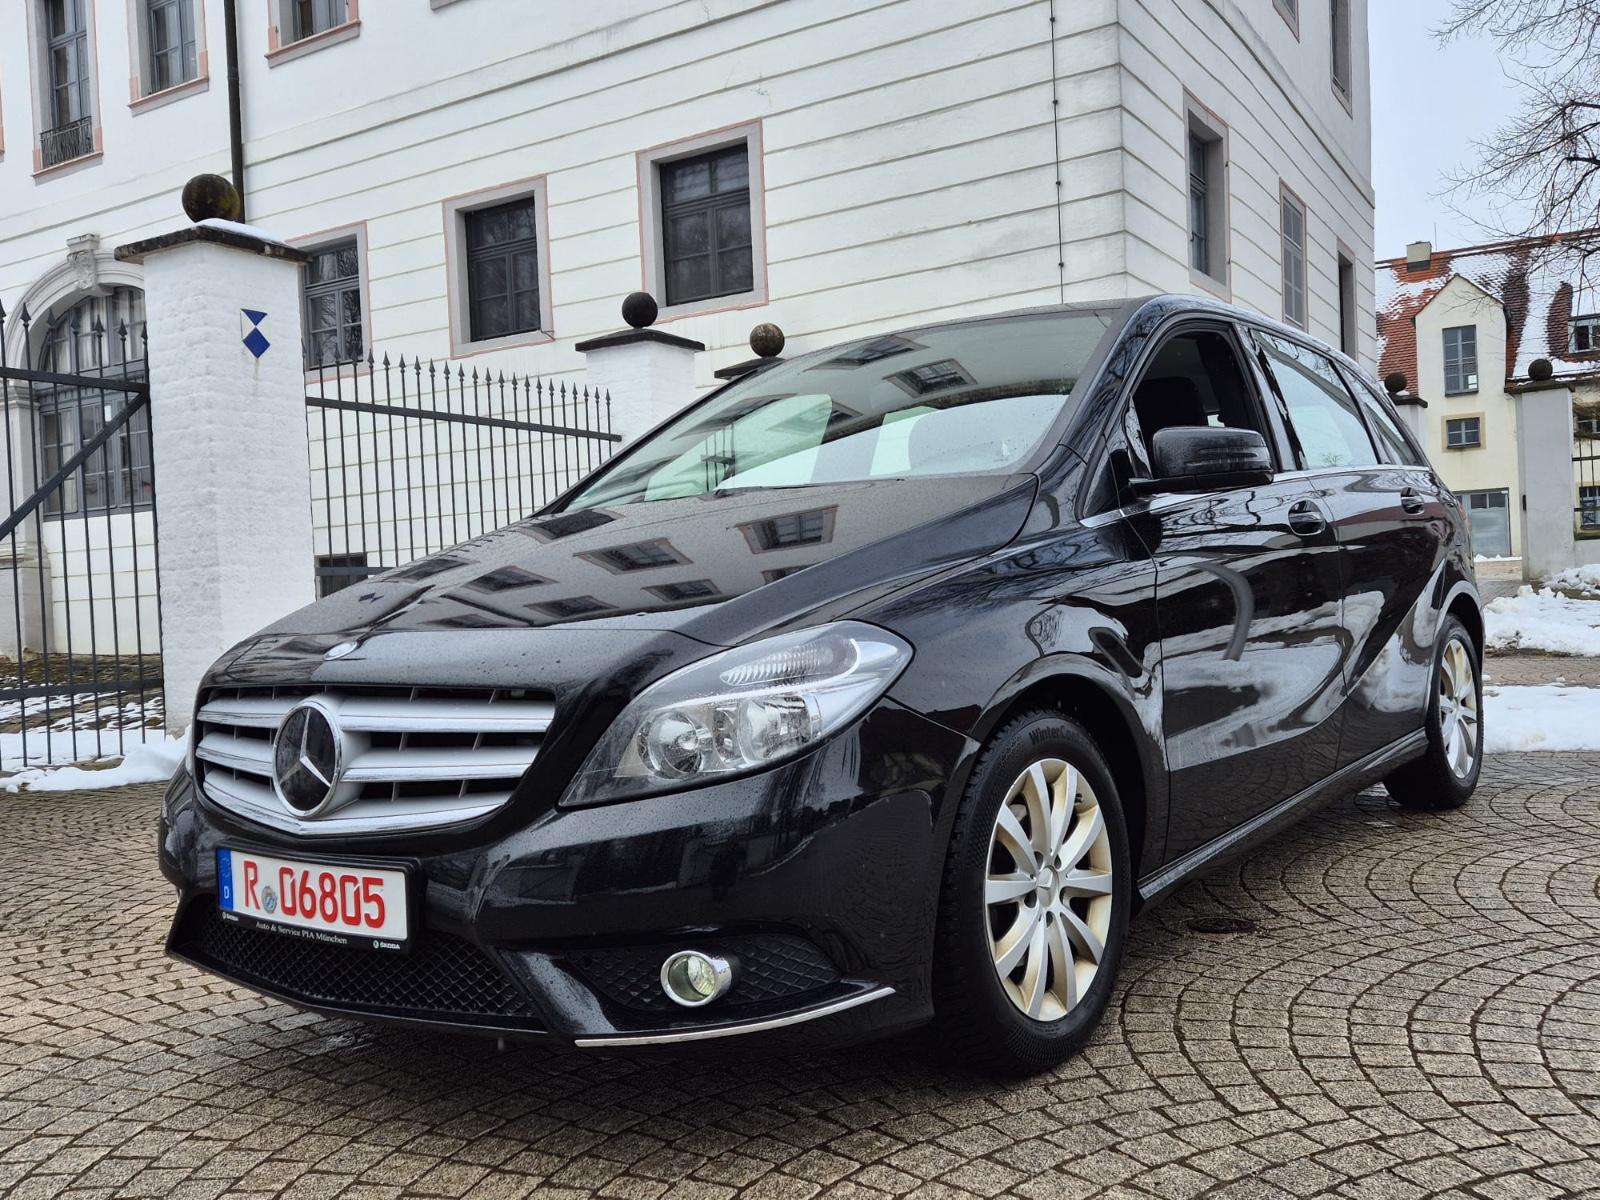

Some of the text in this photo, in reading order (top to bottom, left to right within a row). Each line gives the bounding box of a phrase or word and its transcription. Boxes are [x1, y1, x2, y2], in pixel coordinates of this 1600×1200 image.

[223, 885, 229, 899] D
[244, 861, 385, 928] R 06805
[256, 921, 270, 931] Auto
[278, 925, 301, 936] Service
[302, 930, 315, 940] PIA
[315, 932, 348, 945] München
